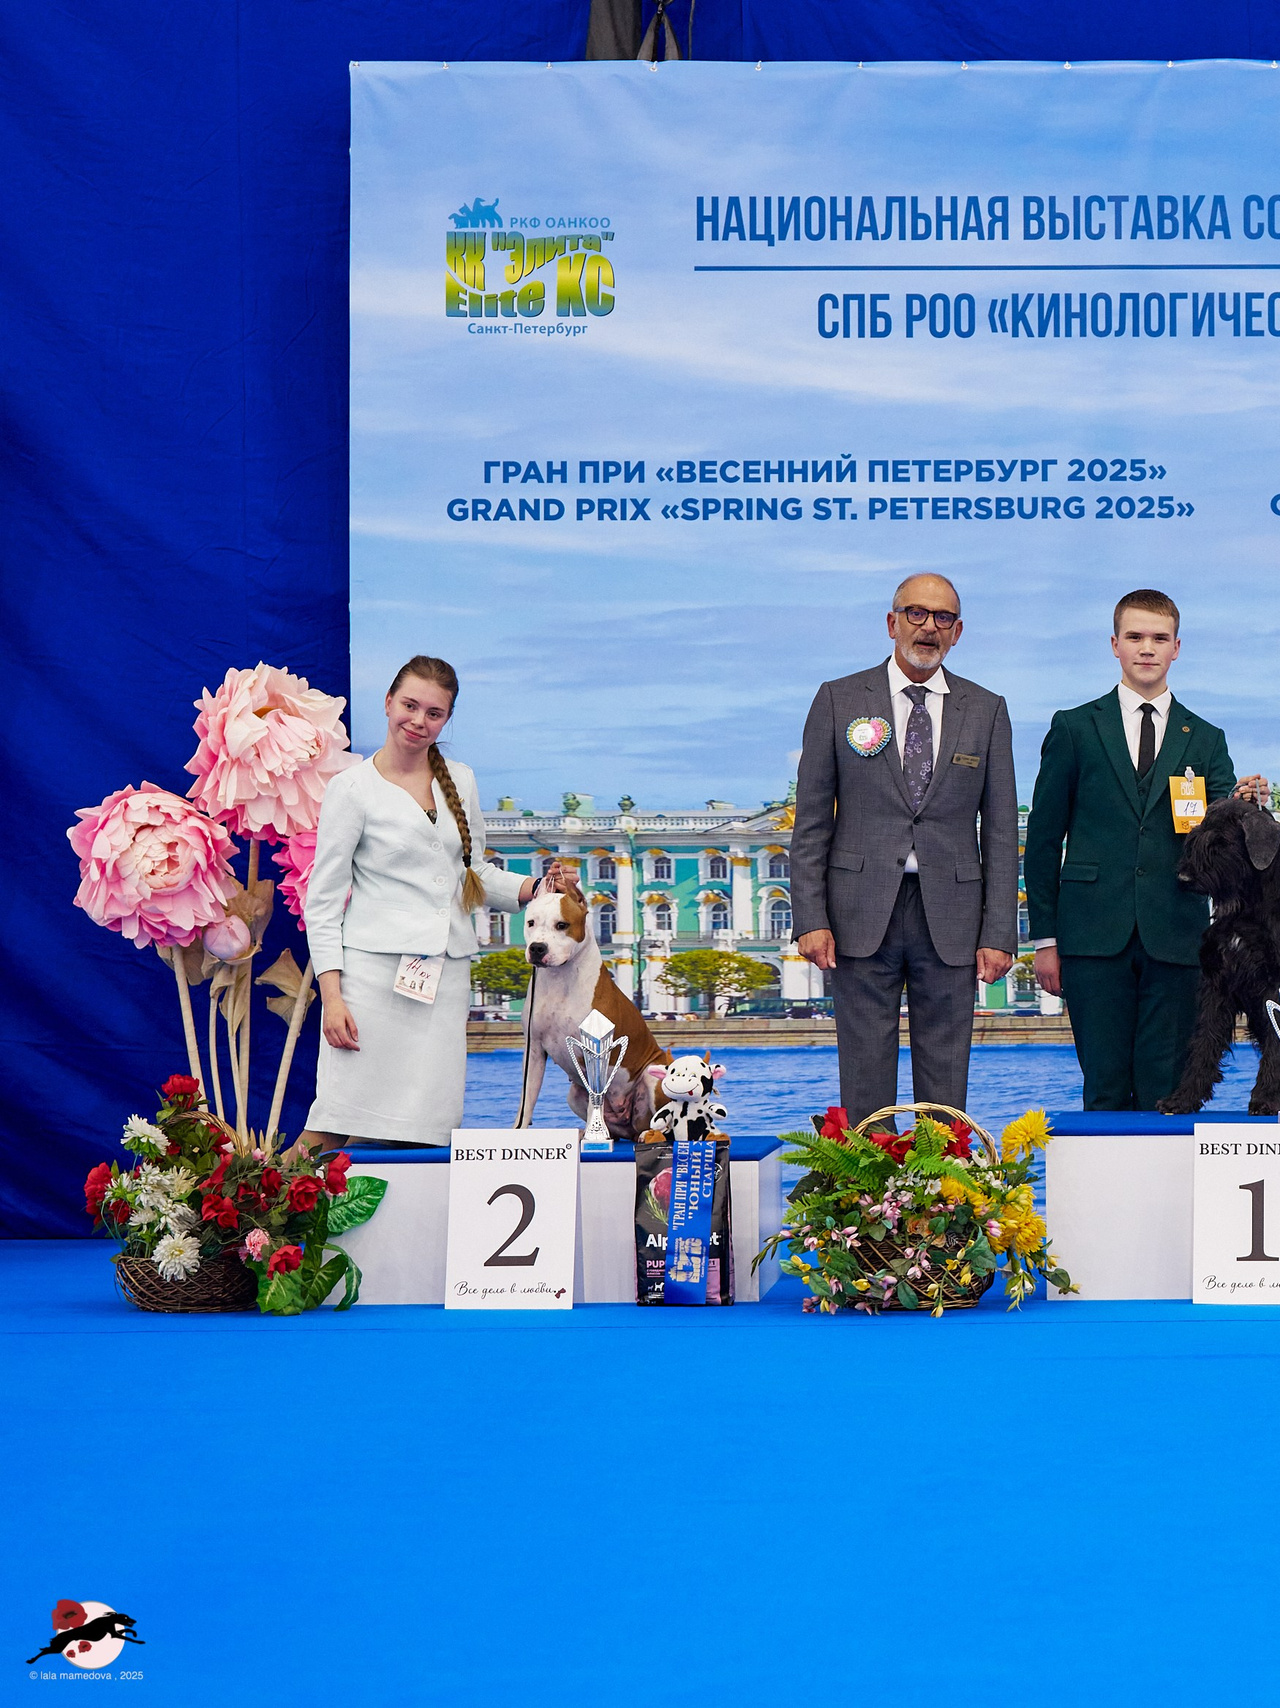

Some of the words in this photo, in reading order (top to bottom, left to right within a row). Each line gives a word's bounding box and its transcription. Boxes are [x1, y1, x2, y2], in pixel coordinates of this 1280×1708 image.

[510, 217, 541, 229] РКФ
[545, 217, 611, 229] ОАНКОО
[696, 195, 1009, 247] НАЦИОНАЛЬНАЯ
[1022, 194, 1232, 241] ВЫСТАВКА
[445, 270, 545, 317] Elite
[817, 293, 893, 339] СПБ
[905, 292, 976, 339] РОО
[467, 322, 588, 337] Санкт-Петербург
[483, 460, 568, 484] ГРАН
[578, 460, 646, 484] ПРИ
[655, 453, 857, 484] «ВЕСЕННИЙ
[868, 459, 1058, 483] ПЕТЕРБУРГ
[1067, 458, 1167, 482] 2025»
[446, 498, 566, 522] GRAND
[576, 497, 652, 521] PRIX
[661, 497, 803, 521] «SPRING
[812, 497, 858, 521] ST.
[868, 495, 1086, 521] PETERSBURG
[1095, 495, 1195, 520] 2025»
[454, 1148, 497, 1161] BEST
[1199, 1143, 1242, 1155] BEST
[675, 1180, 688, 1197] ПРИ
[483, 1183, 540, 1267] 2
[1236, 1179, 1280, 1262] 1
[453, 1280, 479, 1297] Все
[481, 1287, 507, 1300] дело
[1202, 1274, 1227, 1290] Все
[1229, 1282, 1255, 1294] дело
